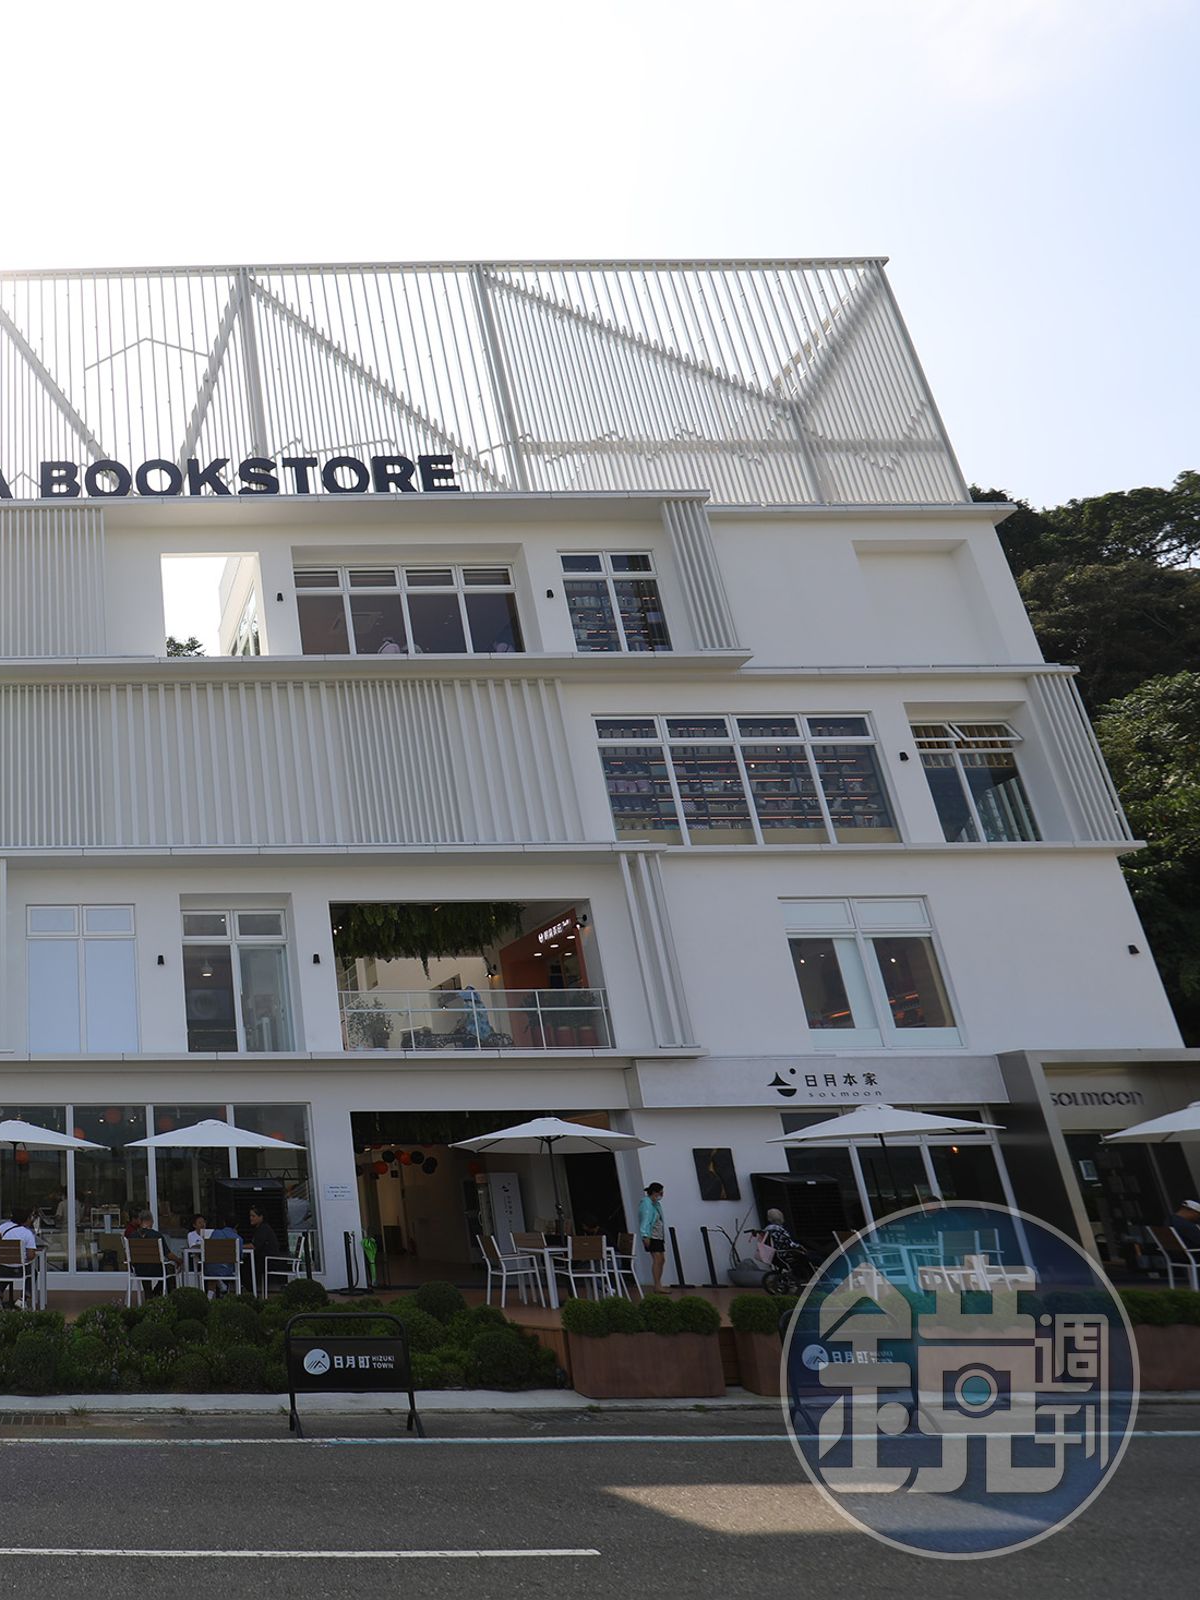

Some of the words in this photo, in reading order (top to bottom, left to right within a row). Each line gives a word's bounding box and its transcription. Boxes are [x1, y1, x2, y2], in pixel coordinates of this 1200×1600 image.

[40, 454, 461, 498] BOOKSTORE
[805, 1072, 879, 1088] 日月本家
[333, 1355, 370, 1369] 日月町
